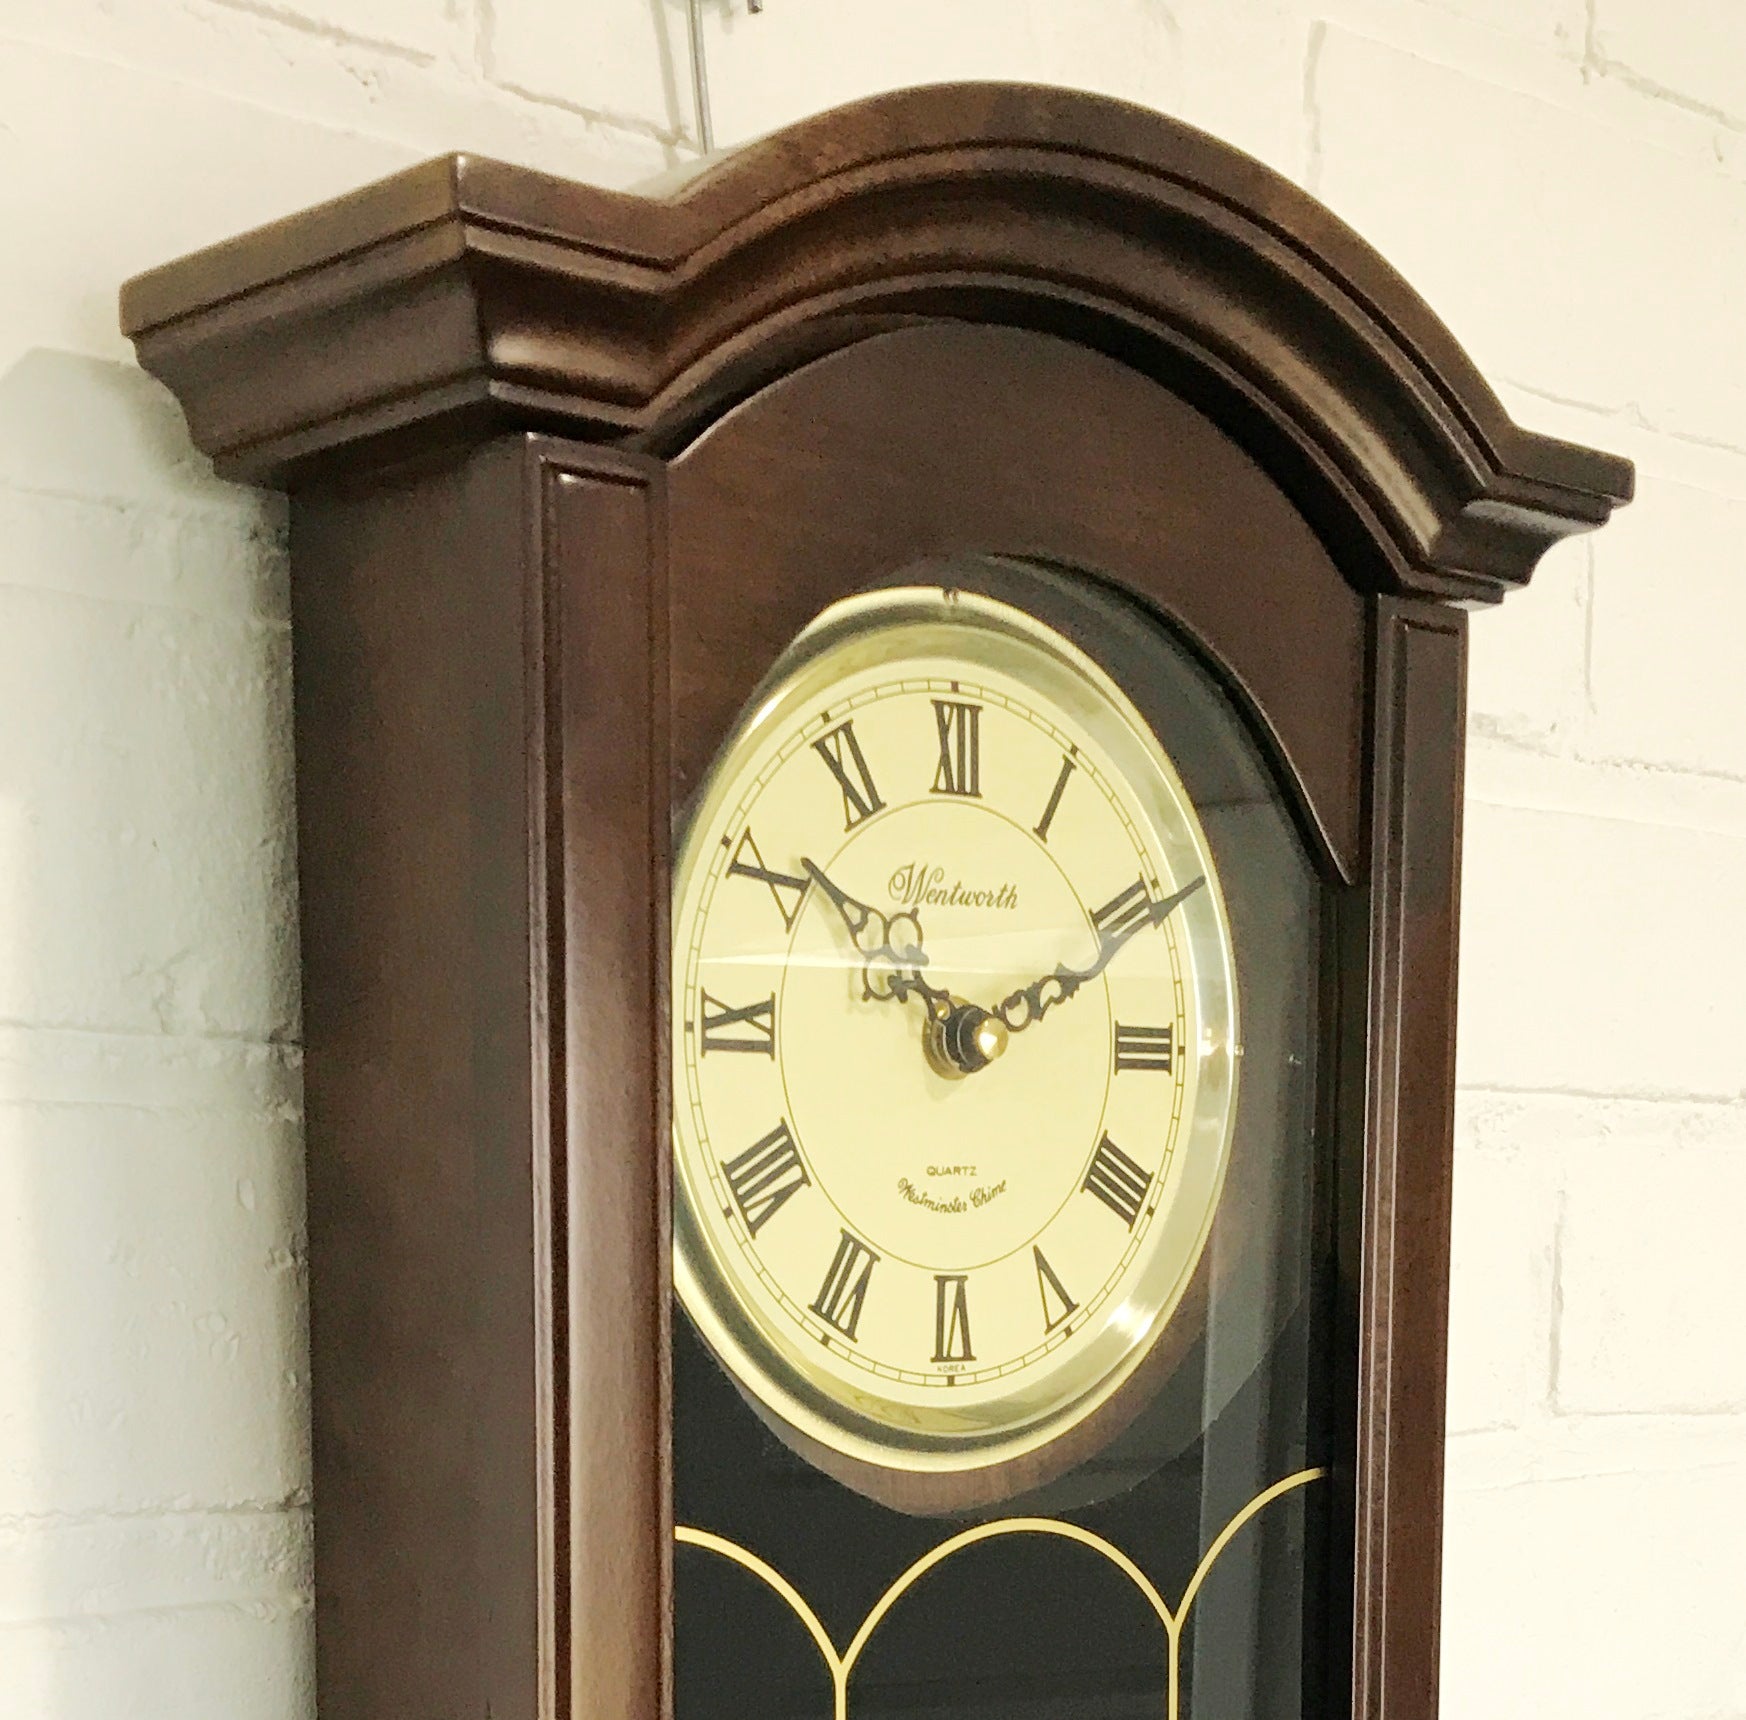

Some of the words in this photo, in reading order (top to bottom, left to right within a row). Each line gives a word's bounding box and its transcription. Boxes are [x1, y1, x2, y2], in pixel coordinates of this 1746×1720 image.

[809, 719, 886, 833] XI
[929, 700, 982, 796] XII
[1033, 754, 1077, 843] I
[726, 826, 813, 933] X
[888, 861, 1018, 910] Wentworth
[700, 987, 775, 1060] IX
[1114, 1020, 1173, 1076] III
[721, 1117, 812, 1239] VIII
[898, 1178, 967, 1213] Westminster
[969, 1179, 1006, 1208] Chime
[926, 1166, 977, 1176] QUARTZ
[1080, 1130, 1155, 1233] IIII
[809, 1230, 880, 1343] VII
[930, 1274, 976, 1363] VI
[1032, 1245, 1079, 1336] V
[937, 1364, 966, 1373] KOREA
